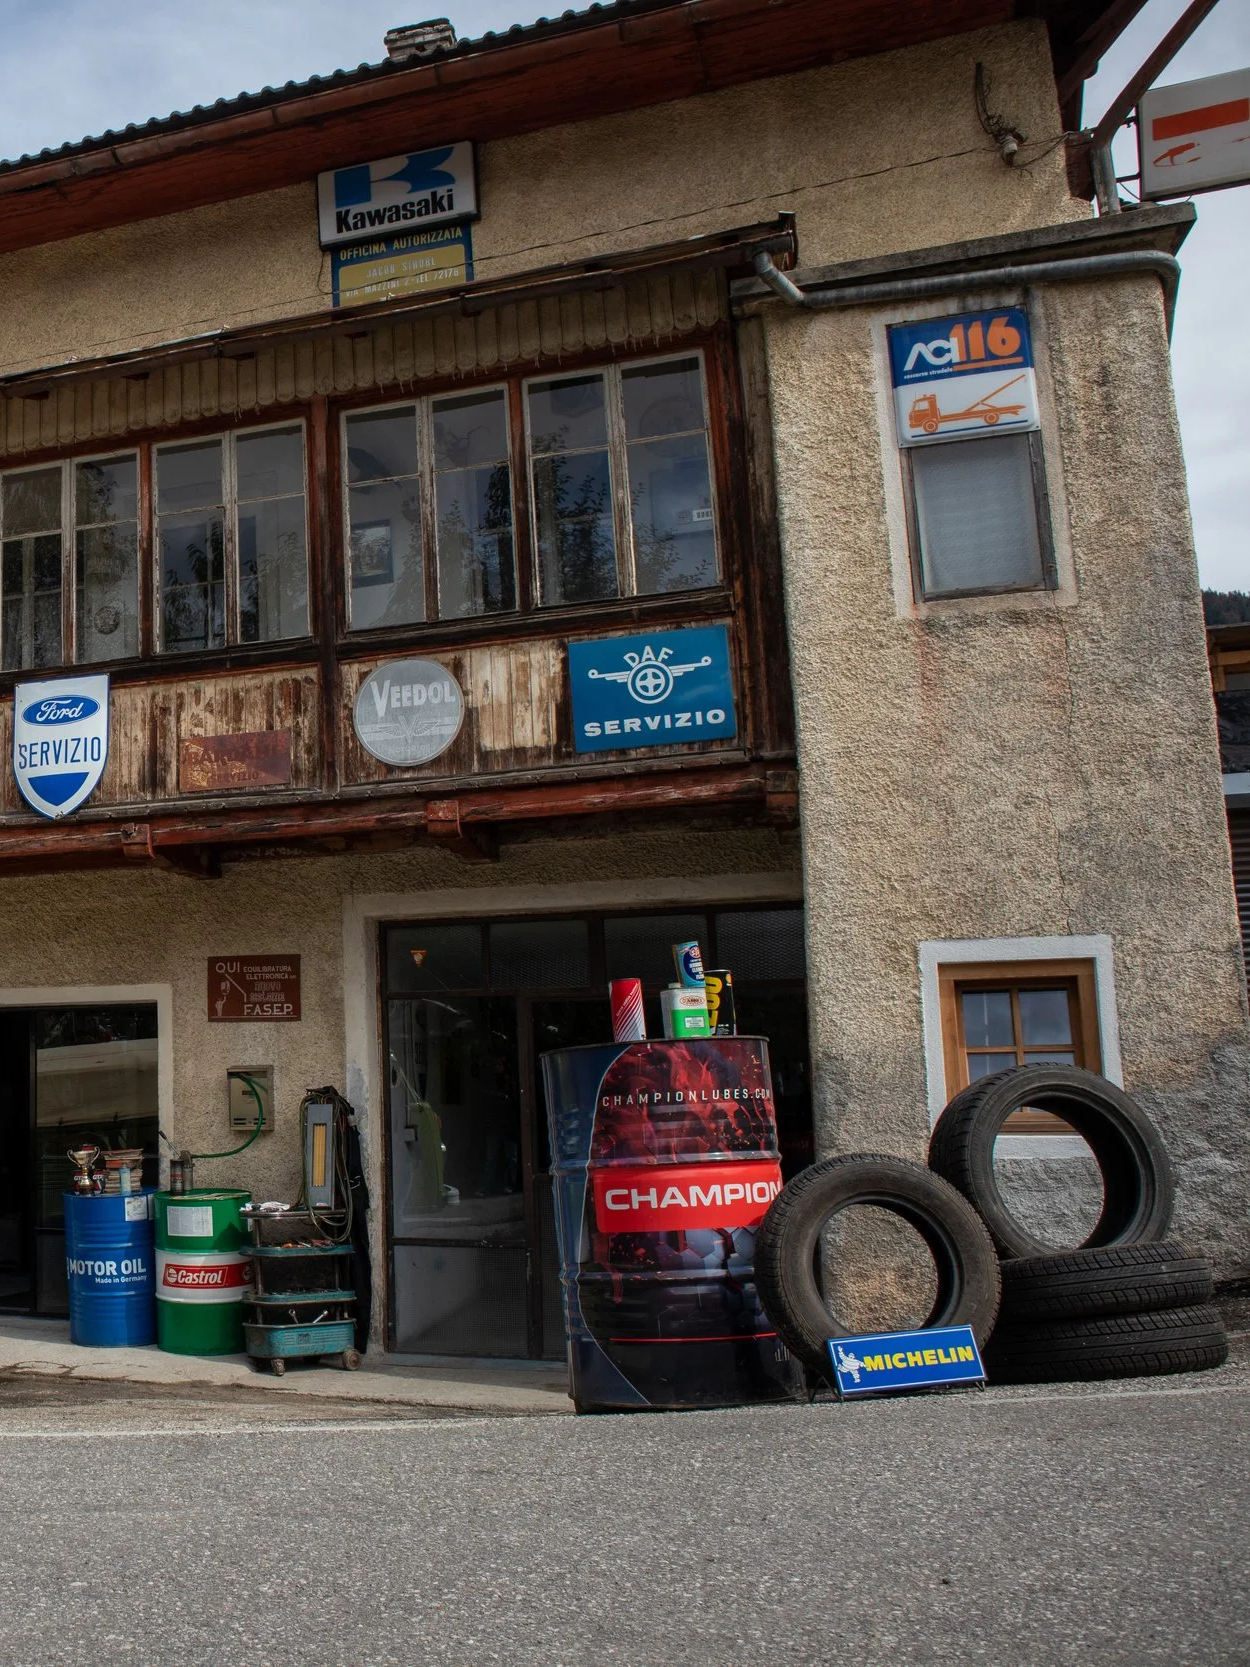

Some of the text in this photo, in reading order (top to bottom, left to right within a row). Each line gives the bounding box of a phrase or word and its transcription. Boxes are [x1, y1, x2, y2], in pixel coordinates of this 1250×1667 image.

[336, 189, 454, 234] Kawasaki
[340, 227, 462, 261] OFFICINA AUTORIZZATA
[364, 280, 400, 293] MAZZINI
[903, 316, 1021, 371] ACI 116
[623, 645, 674, 668] DAF
[36, 699, 84, 721] Ford
[370, 680, 456, 718] VEEDOL
[584, 708, 726, 737] SERVIZIO
[18, 736, 101, 769] SERVIZIO
[215, 961, 292, 974] QUI EQUILIBRATURA
[246, 972, 289, 981] ELETTRONICA
[605, 1181, 783, 1211] CHAMPION
[69, 1258, 146, 1276] MOTOR OIL
[177, 1270, 222, 1284] Castrol
[120, 1275, 147, 1284] Germany
[863, 1346, 975, 1371] MICHELIN
